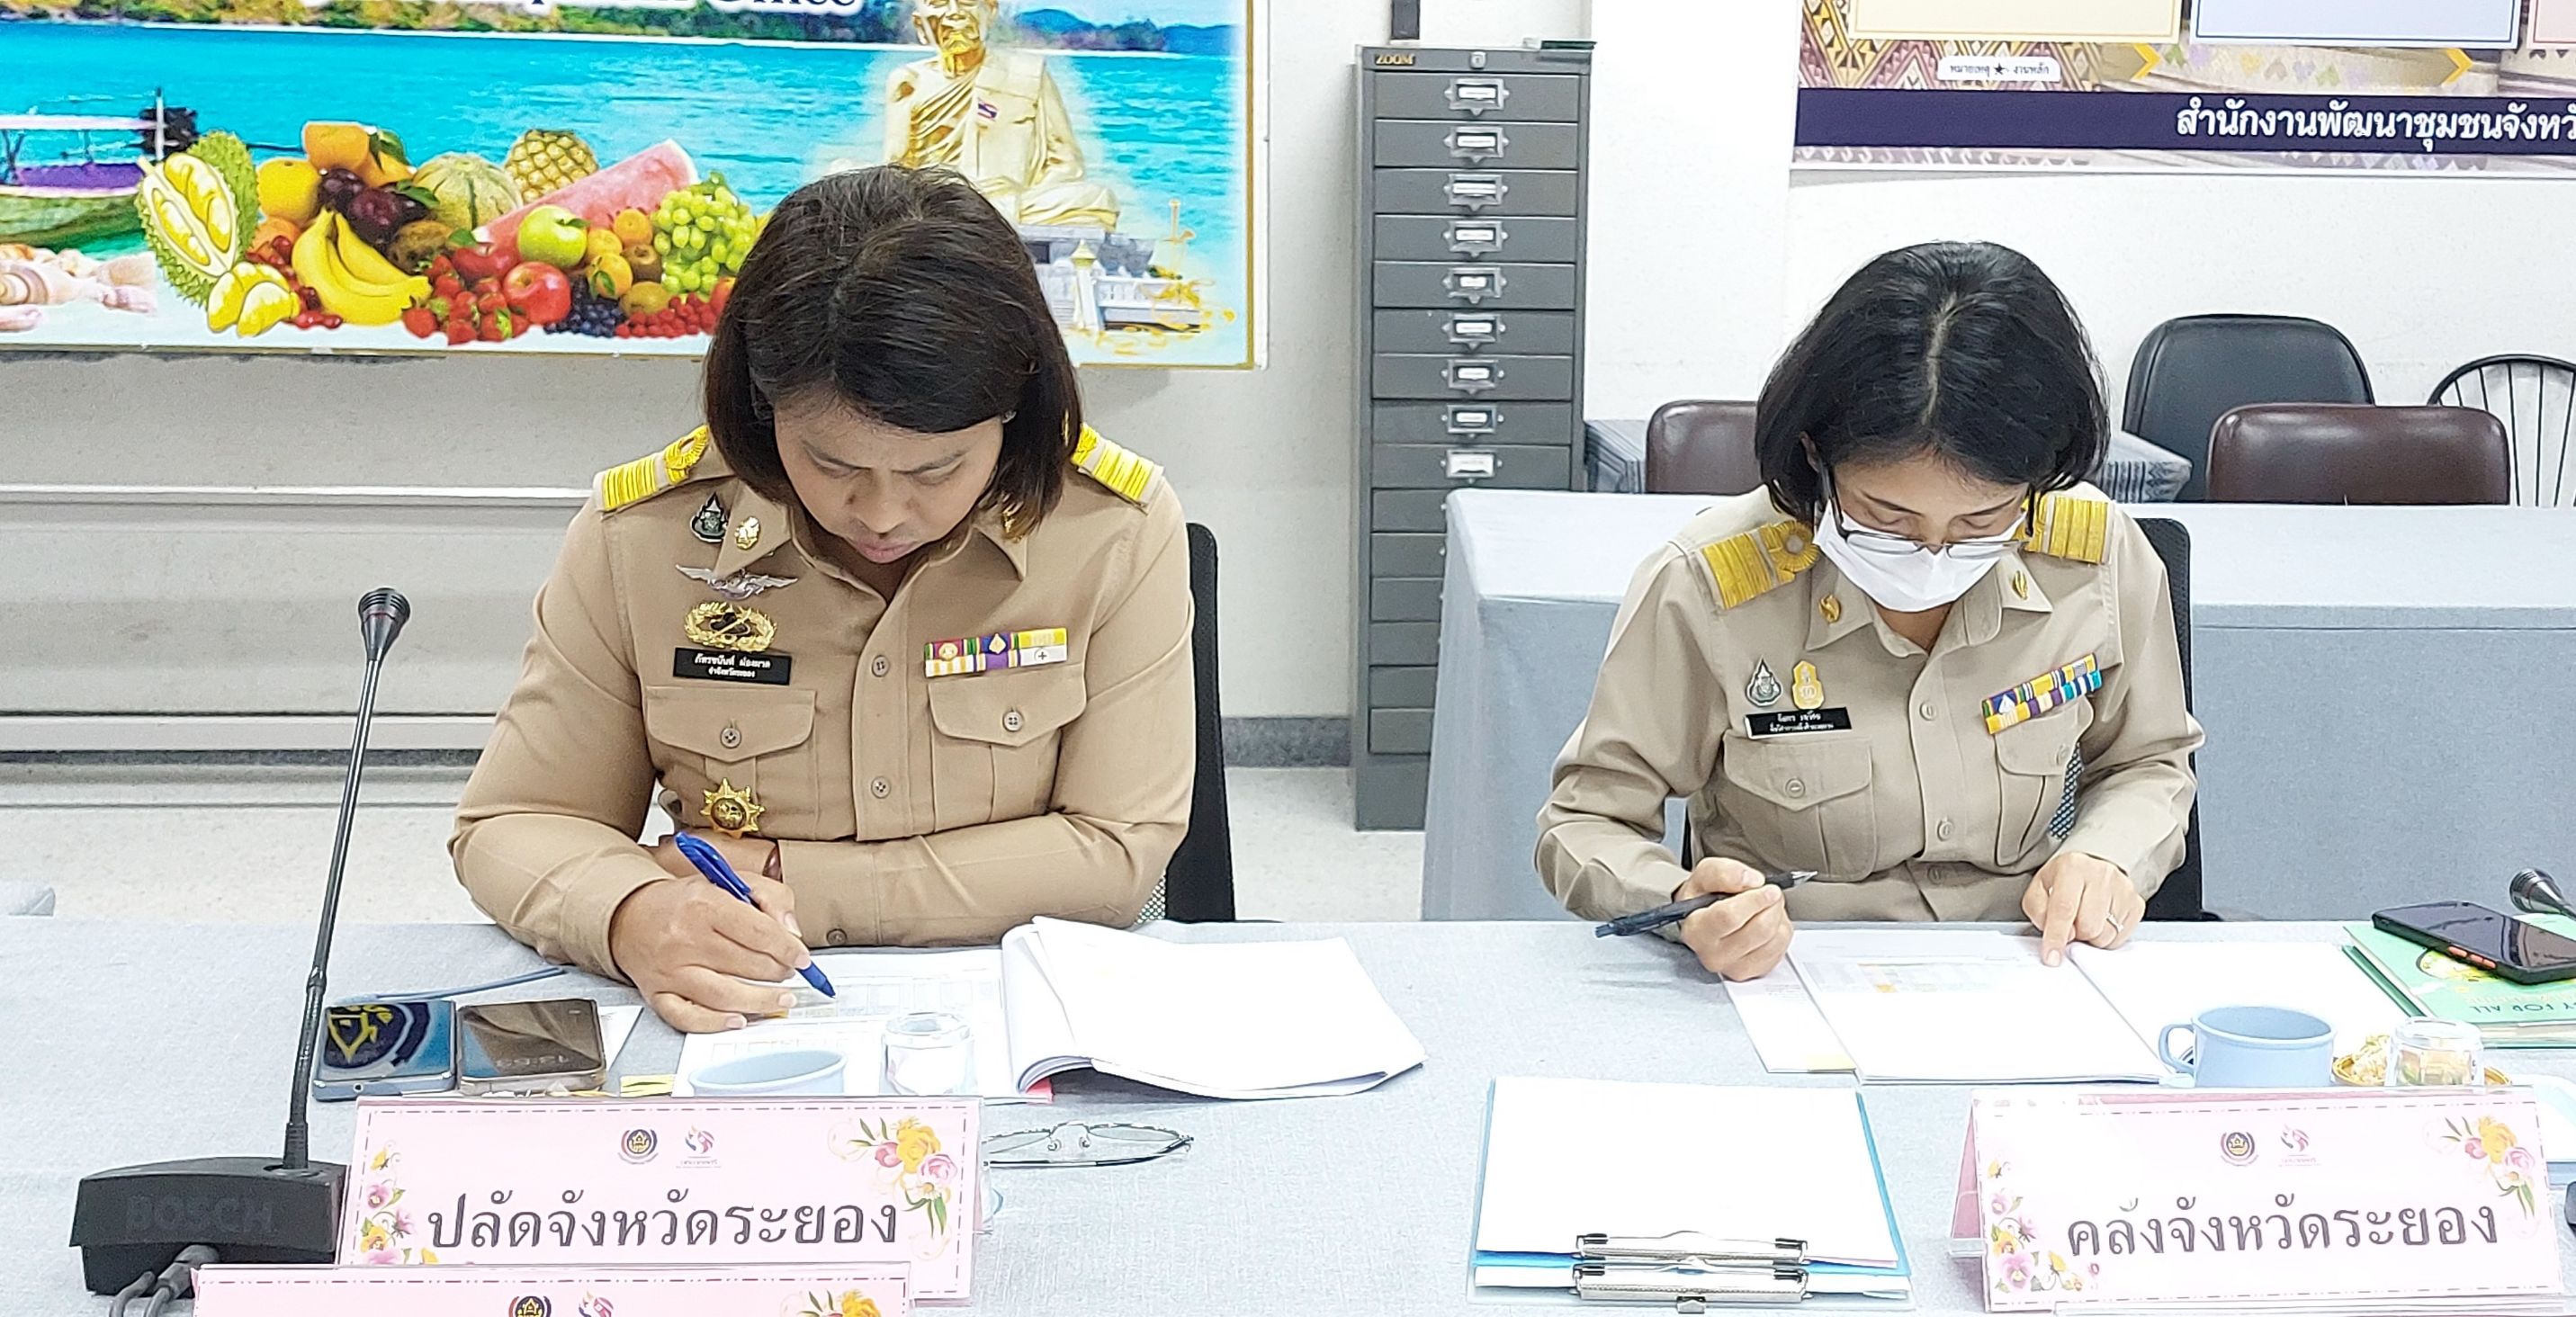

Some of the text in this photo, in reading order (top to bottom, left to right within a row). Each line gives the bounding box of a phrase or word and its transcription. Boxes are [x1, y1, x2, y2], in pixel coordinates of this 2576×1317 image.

[1376, 53, 1415, 65] ZOOM
[125, 1195, 274, 1233] BOSCH
[427, 1188, 896, 1248] ปลัดจังหวัดระยอง
[2068, 1193, 2499, 1257] คลังจังหวัดระยอง
